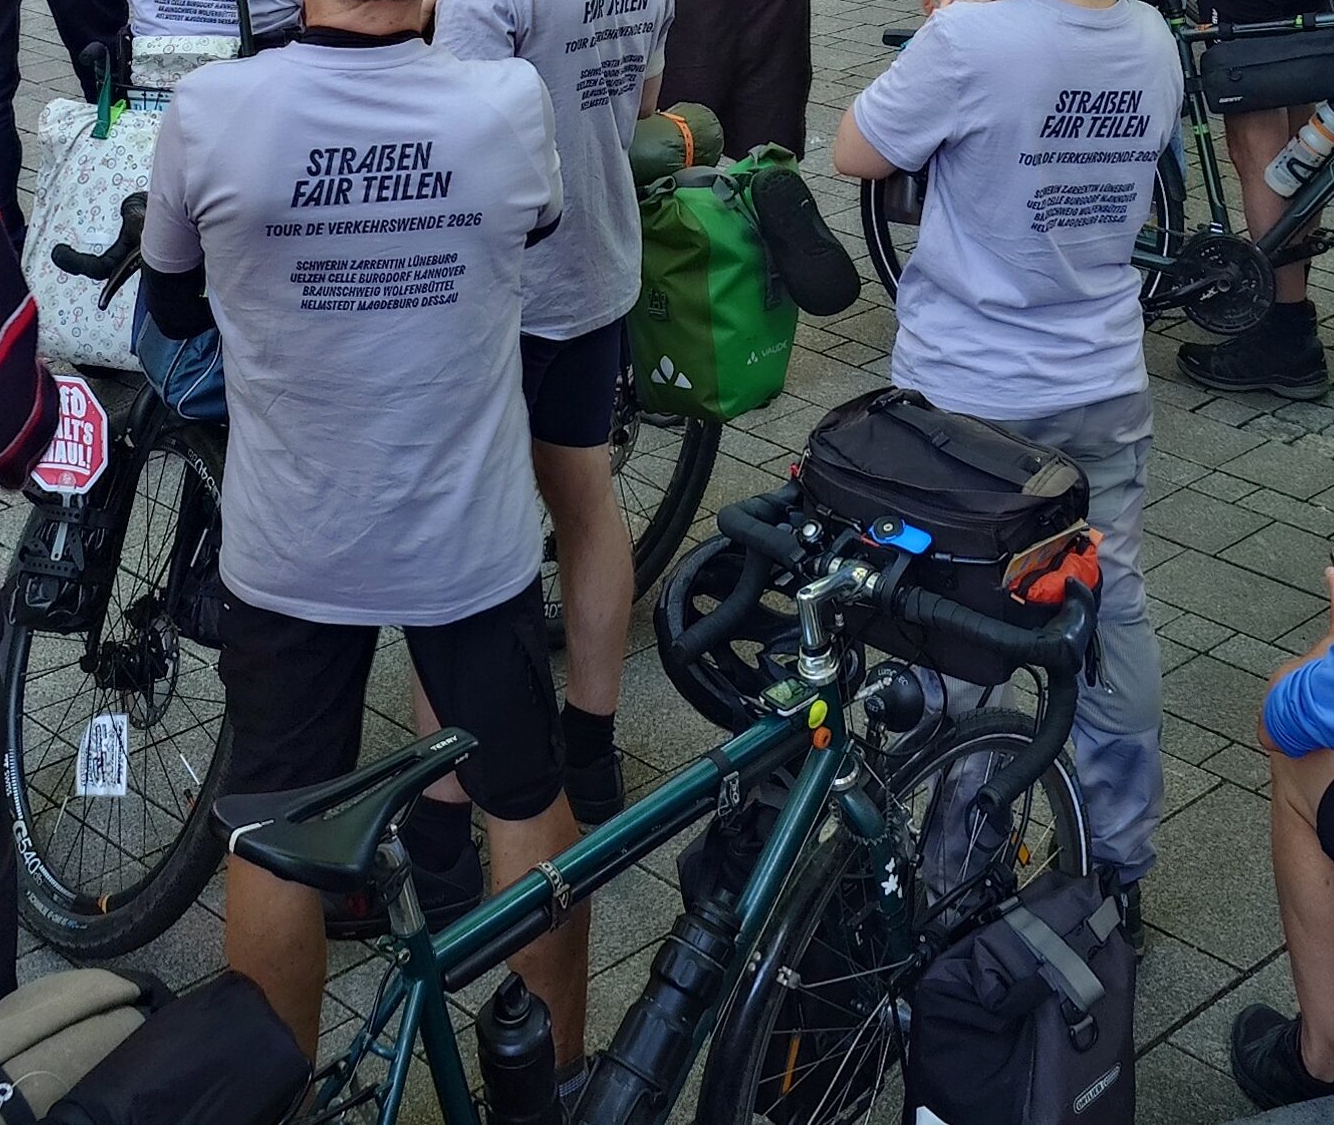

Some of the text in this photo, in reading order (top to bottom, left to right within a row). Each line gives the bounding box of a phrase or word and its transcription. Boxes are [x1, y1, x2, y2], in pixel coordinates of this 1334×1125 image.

[565, 36, 588, 54] TOUR
[1055, 90, 1143, 114] STRAßEN
[1040, 115, 1151, 139] FAIR TEILEN
[306, 141, 433, 177] STRAßEN
[1019, 153, 1042, 167] TOUR
[1042, 152, 1056, 164] DE
[1056, 150, 1137, 164] VERKEHRSWENDE
[290, 171, 453, 208] FAIR TEILEN
[265, 212, 483, 237] TOUR DE VERKEHRSWENDE 2026
[295, 253, 458, 272] SCHWERIN ZARRENTIN LÜNEBURG
[290, 265, 466, 284] UELZEN CELLE BURGDORF HANNOVER
[302, 280, 455, 298] BRAUNSCHWEIG WOLFENBÜTTEL
[300, 292, 459, 311] HELMSTEDT MAGDEBURG DESSAU
[761, 339, 788, 357] VAUDE
[53, 417, 94, 445] ALT'S
[429, 735, 458, 752] TERRY
